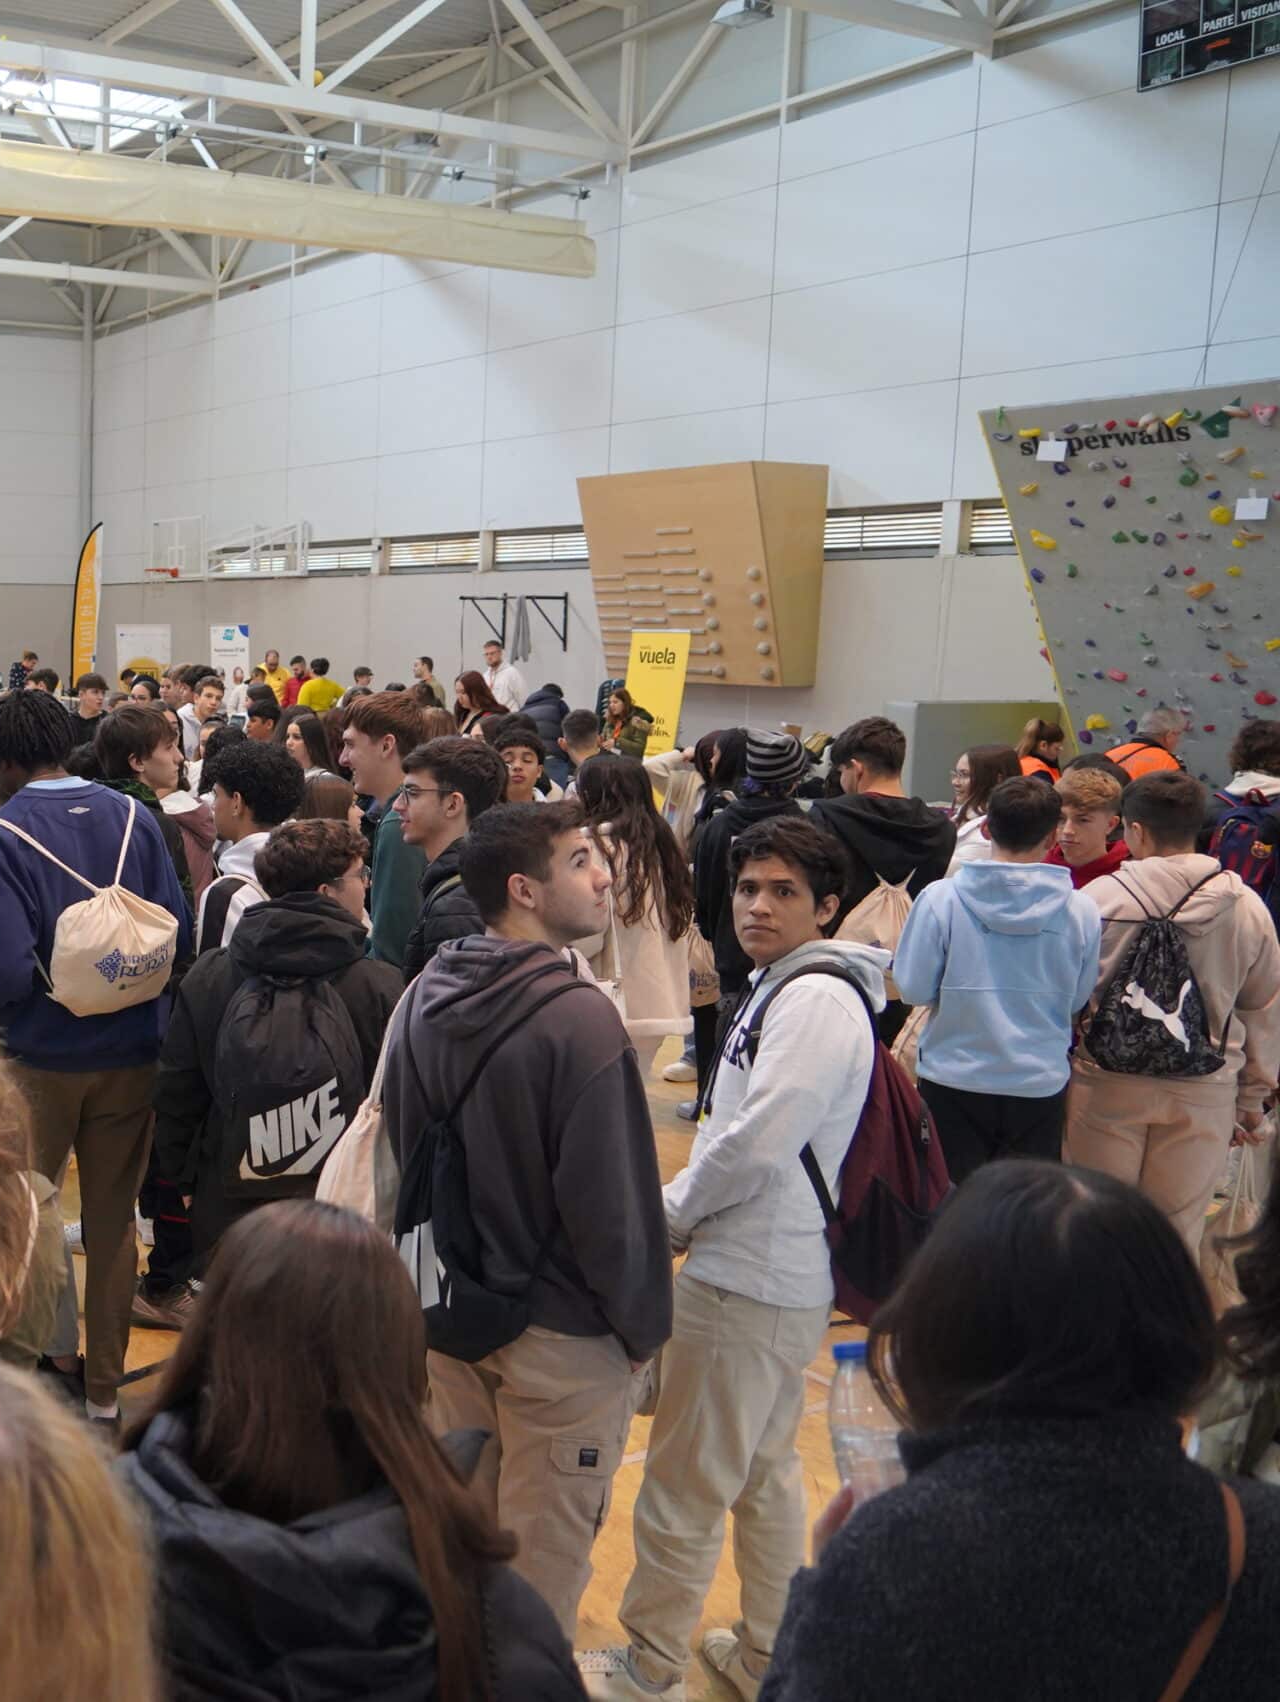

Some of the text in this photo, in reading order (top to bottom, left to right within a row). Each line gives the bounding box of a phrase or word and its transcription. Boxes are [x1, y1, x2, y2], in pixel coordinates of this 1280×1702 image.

[1155, 28, 1186, 47] LOCAL
[639, 647, 676, 664] vuela
[249, 1076, 340, 1167] NIKE
